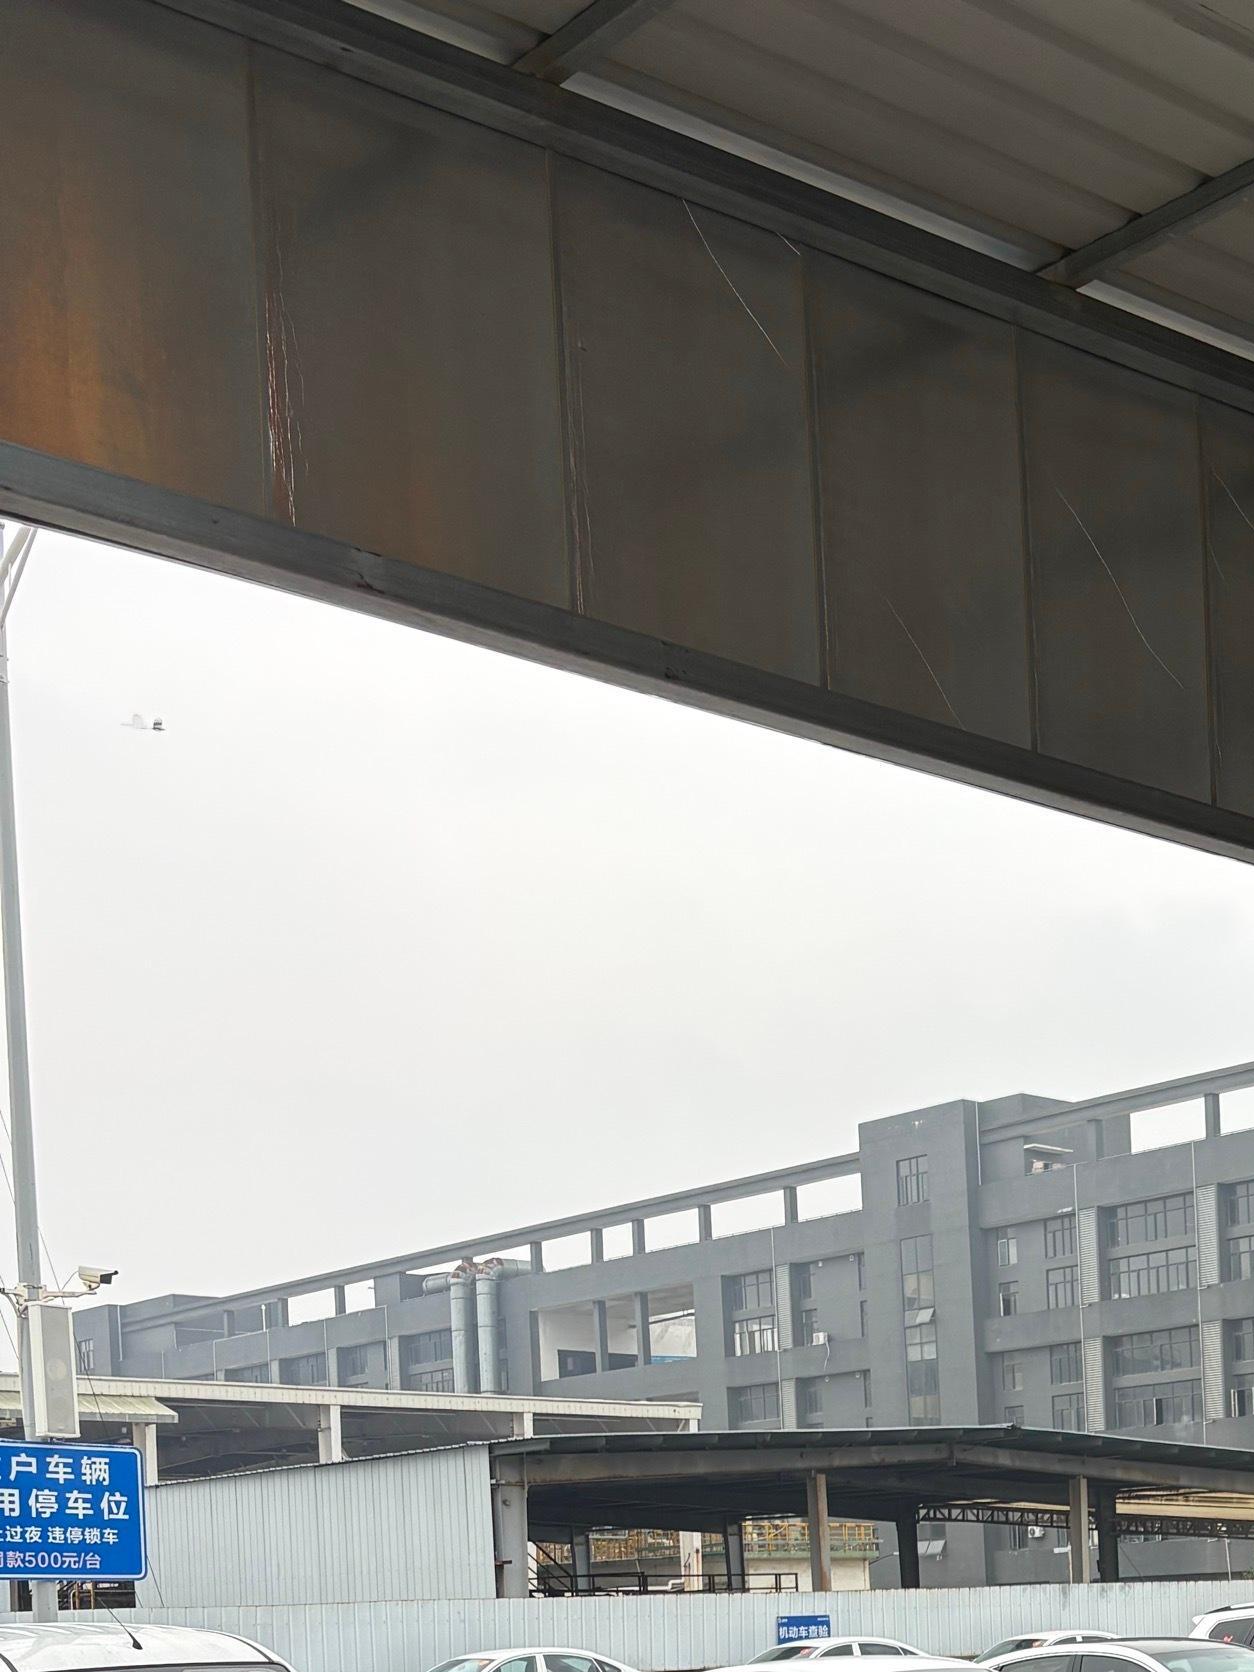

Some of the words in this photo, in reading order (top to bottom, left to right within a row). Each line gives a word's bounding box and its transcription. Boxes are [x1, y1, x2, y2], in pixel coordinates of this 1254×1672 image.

[0, 1453, 110, 1486] 户车辆
[0, 1525, 43, 1544] 过夜
[47, 1527, 119, 1545] 违停锁车
[0, 1550, 102, 1570] 款500元/台
[779, 1625, 829, 1640] 机动车查验
